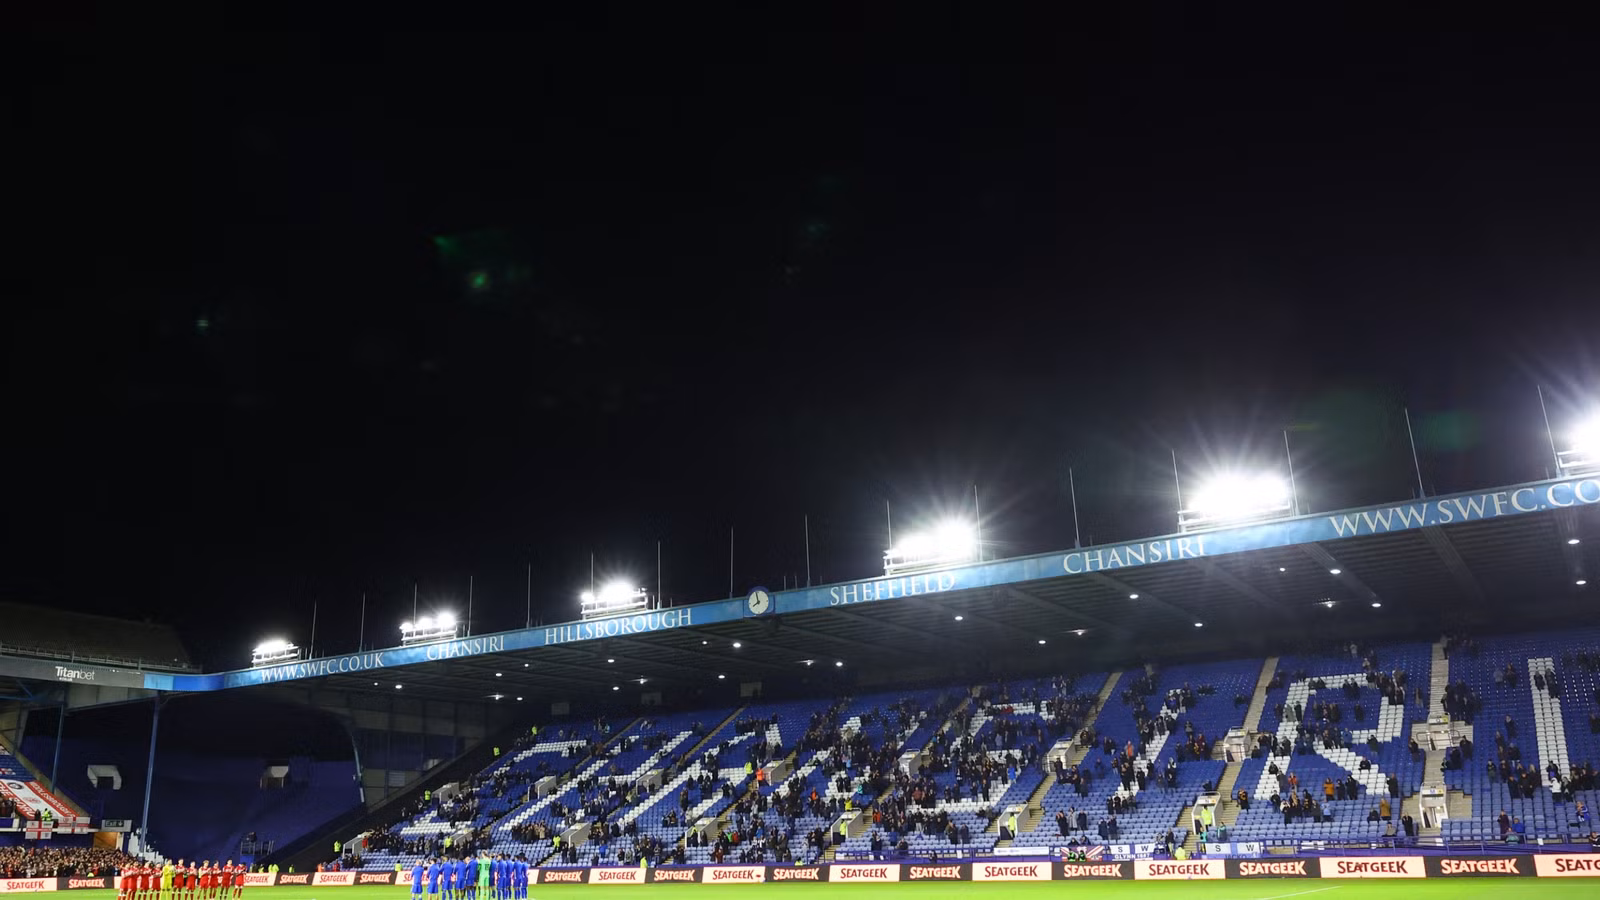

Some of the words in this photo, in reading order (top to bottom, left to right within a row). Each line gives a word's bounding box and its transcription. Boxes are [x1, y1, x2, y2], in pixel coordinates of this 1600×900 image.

[1063, 536, 1205, 574] CHANSIRI
[830, 574, 955, 606] SHEFFIELD
[544, 608, 693, 645] HILLSBOROUGH
[426, 635, 505, 660] CHANSIRI
[55, 666, 95, 680] Titanbet
[260, 652, 385, 683] WWW.SWFC.CO.UK
[1215, 844, 1222, 853] S
[1245, 844, 1255, 852] W
[910, 866, 961, 879] SEATGEEK
[984, 865, 1038, 877] SEATGEEK
[1064, 863, 1122, 878] SEATGEEK
[1149, 863, 1210, 876] SEATGEEK
[1239, 860, 1308, 876] SEATGEEK
[1337, 860, 1408, 874] SEATGEEK
[1440, 858, 1520, 874] SEATGEEK
[280, 874, 309, 884] SEATGEEK
[319, 874, 348, 883] SEATGEEK
[360, 873, 390, 884] SEATGEEK
[545, 870, 583, 882] SEATGEEK
[598, 870, 637, 881] SEATGEEK
[654, 869, 696, 881] SEATGEEK
[712, 868, 755, 880] SEATGEEK
[773, 867, 820, 880] SEATGEEK
[840, 867, 888, 879] SEATGEEK
[68, 878, 105, 889] SEATGEEK
